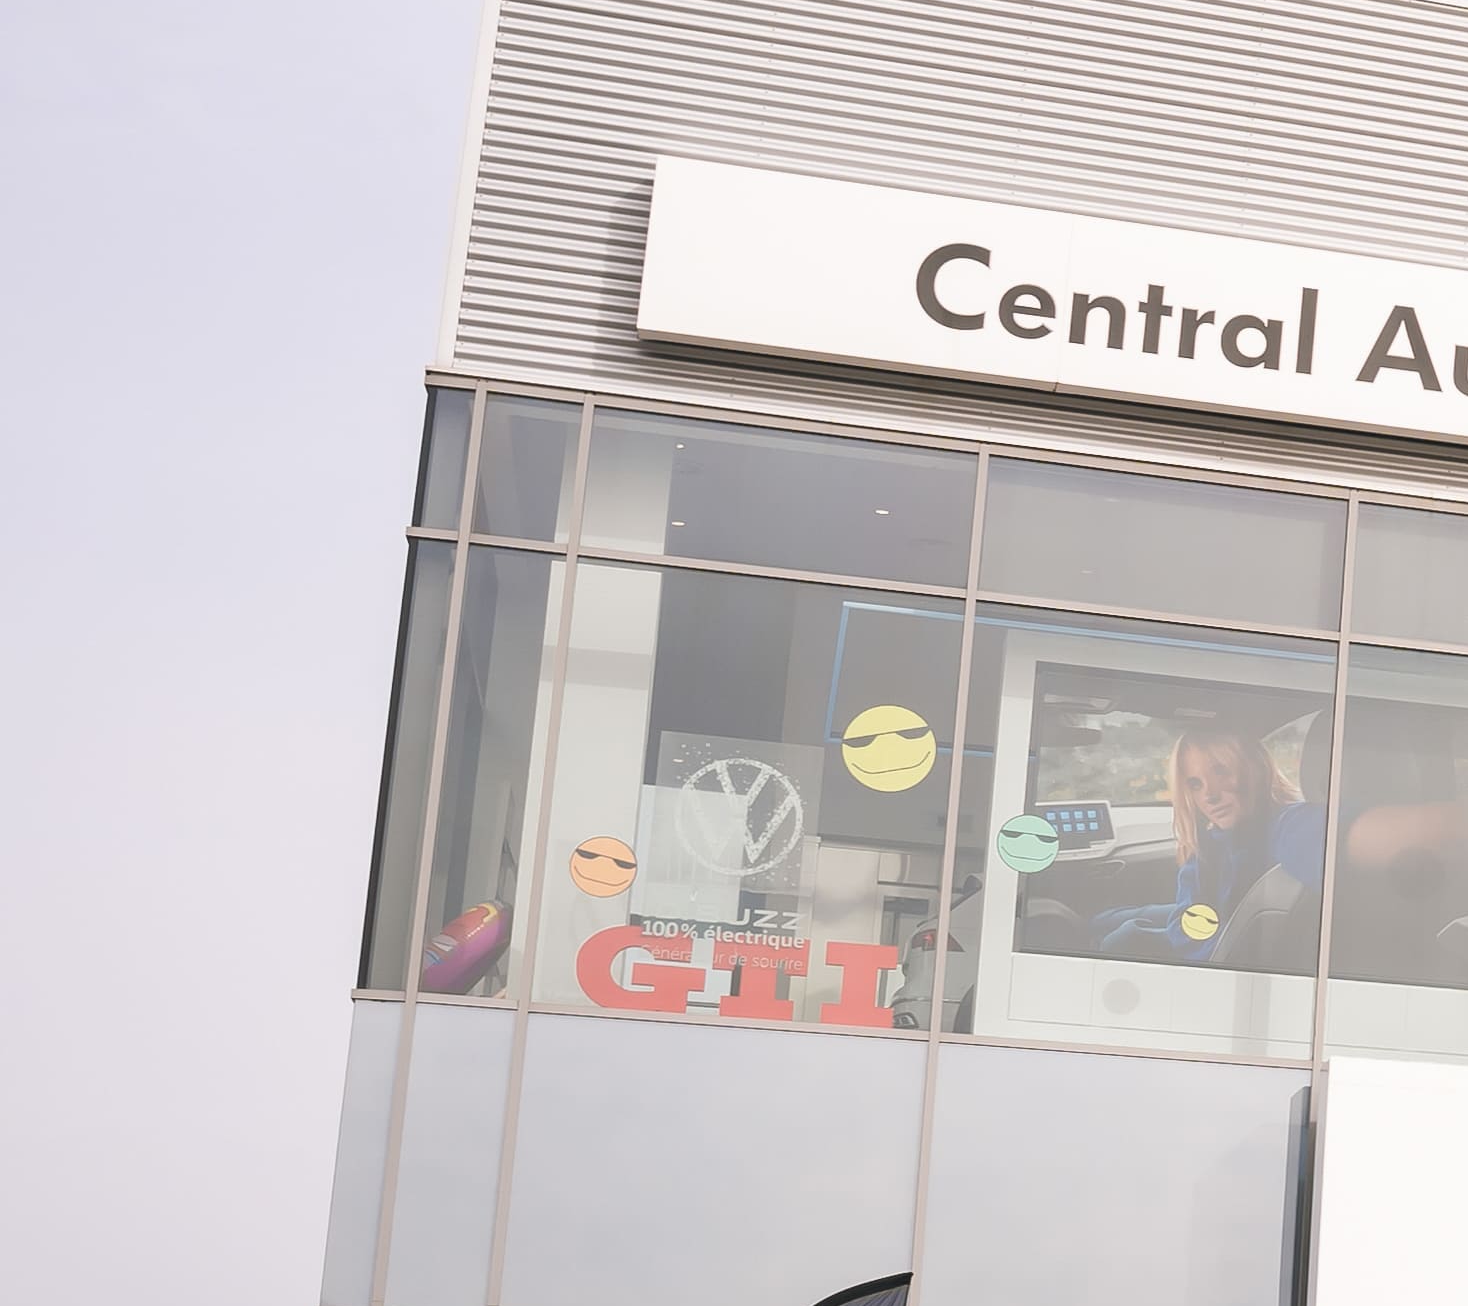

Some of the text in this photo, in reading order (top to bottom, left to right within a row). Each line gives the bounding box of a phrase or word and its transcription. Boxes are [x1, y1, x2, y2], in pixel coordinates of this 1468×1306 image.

[915, 242, 1319, 375] Central
[703, 925, 806, 950] électrique
[751, 956, 804, 971] sourire
[576, 925, 899, 1028] GTI
